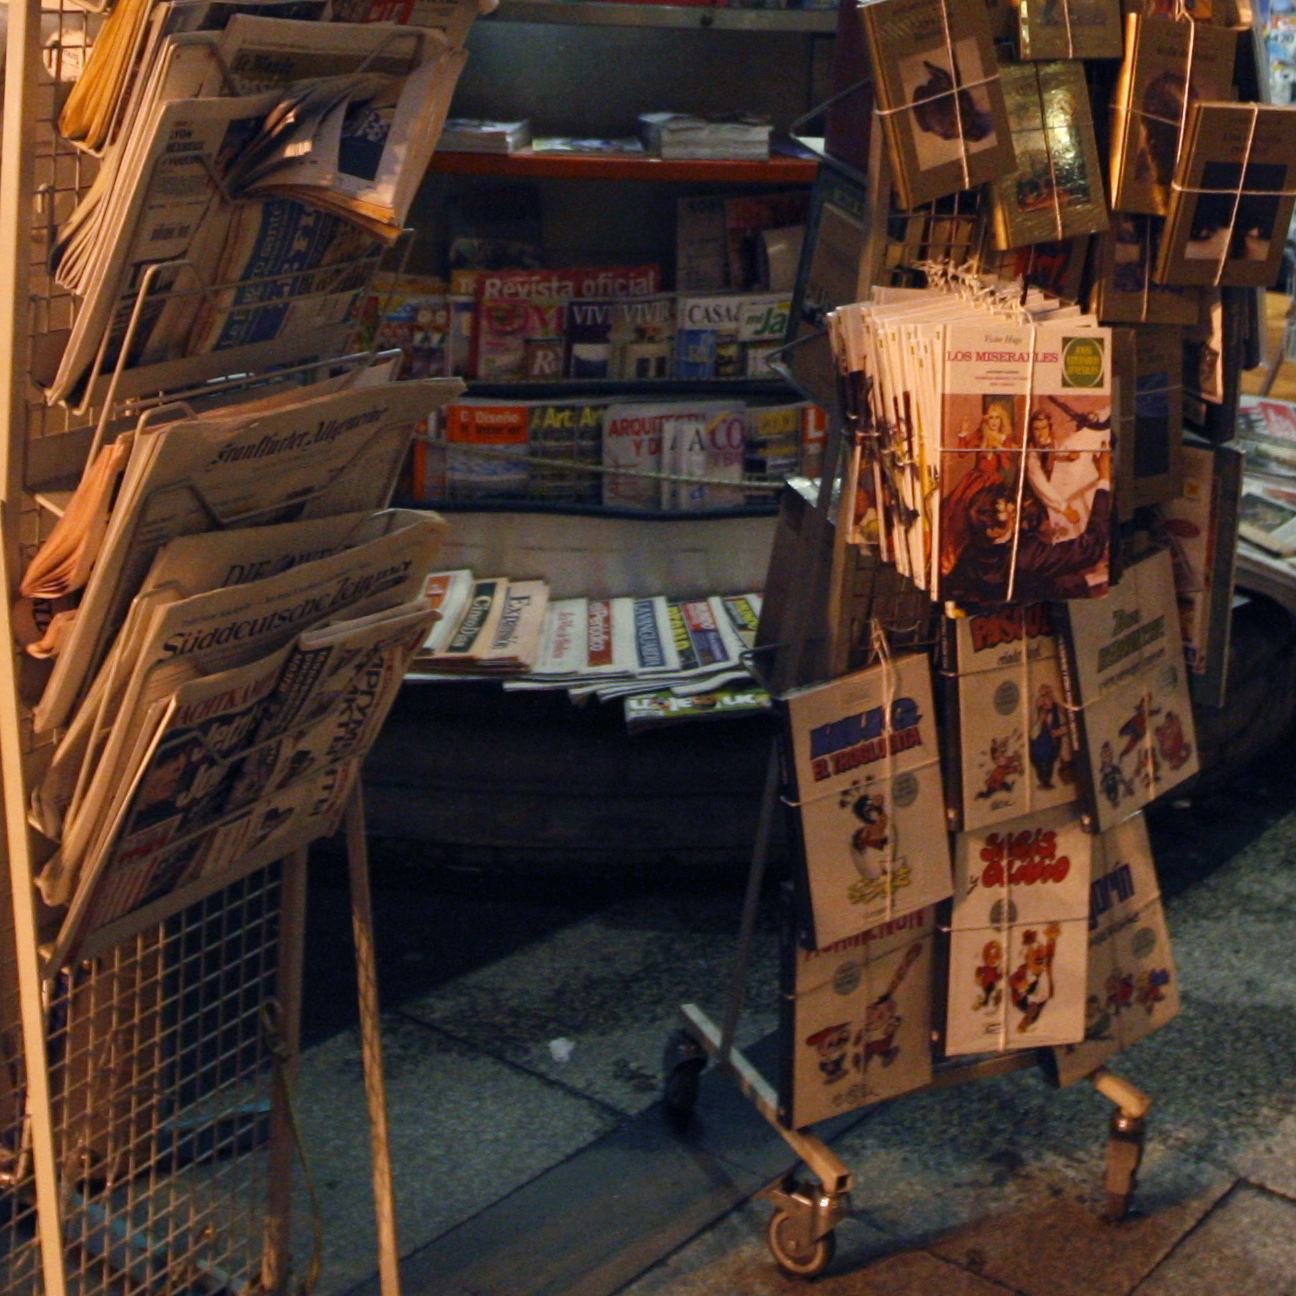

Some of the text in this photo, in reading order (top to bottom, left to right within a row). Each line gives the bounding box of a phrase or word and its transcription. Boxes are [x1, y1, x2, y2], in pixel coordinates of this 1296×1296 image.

[484, 271, 655, 300] Revista oficial
[945, 351, 972, 363] LOS
[163, 592, 330, 656] Süddeutsche
[637, 614, 664, 667] VANGUARDIA
